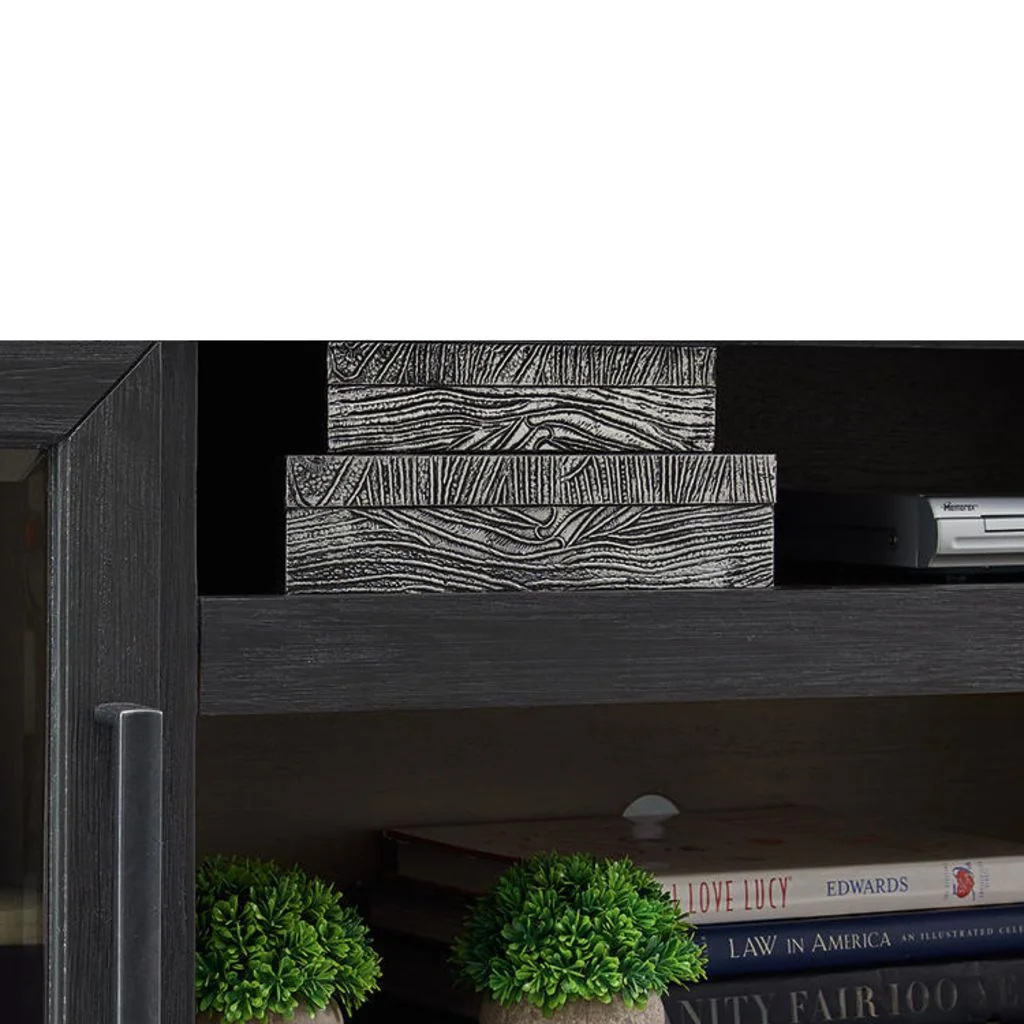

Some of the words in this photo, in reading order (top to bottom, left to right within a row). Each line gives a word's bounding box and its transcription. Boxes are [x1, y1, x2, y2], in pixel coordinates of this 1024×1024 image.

[689, 880, 734, 914] LOVE
[744, 877, 788, 911] LUCY
[826, 876, 909, 897] EDWARDS
[729, 935, 778, 959] LAW
[787, 937, 804, 955] IN
[812, 931, 891, 953] AMERICA
[902, 934, 915, 942] AN
[921, 927, 994, 941] ILLUSTRATED
[790, 984, 879, 1024] FAIR
[888, 978, 959, 1017] 100
